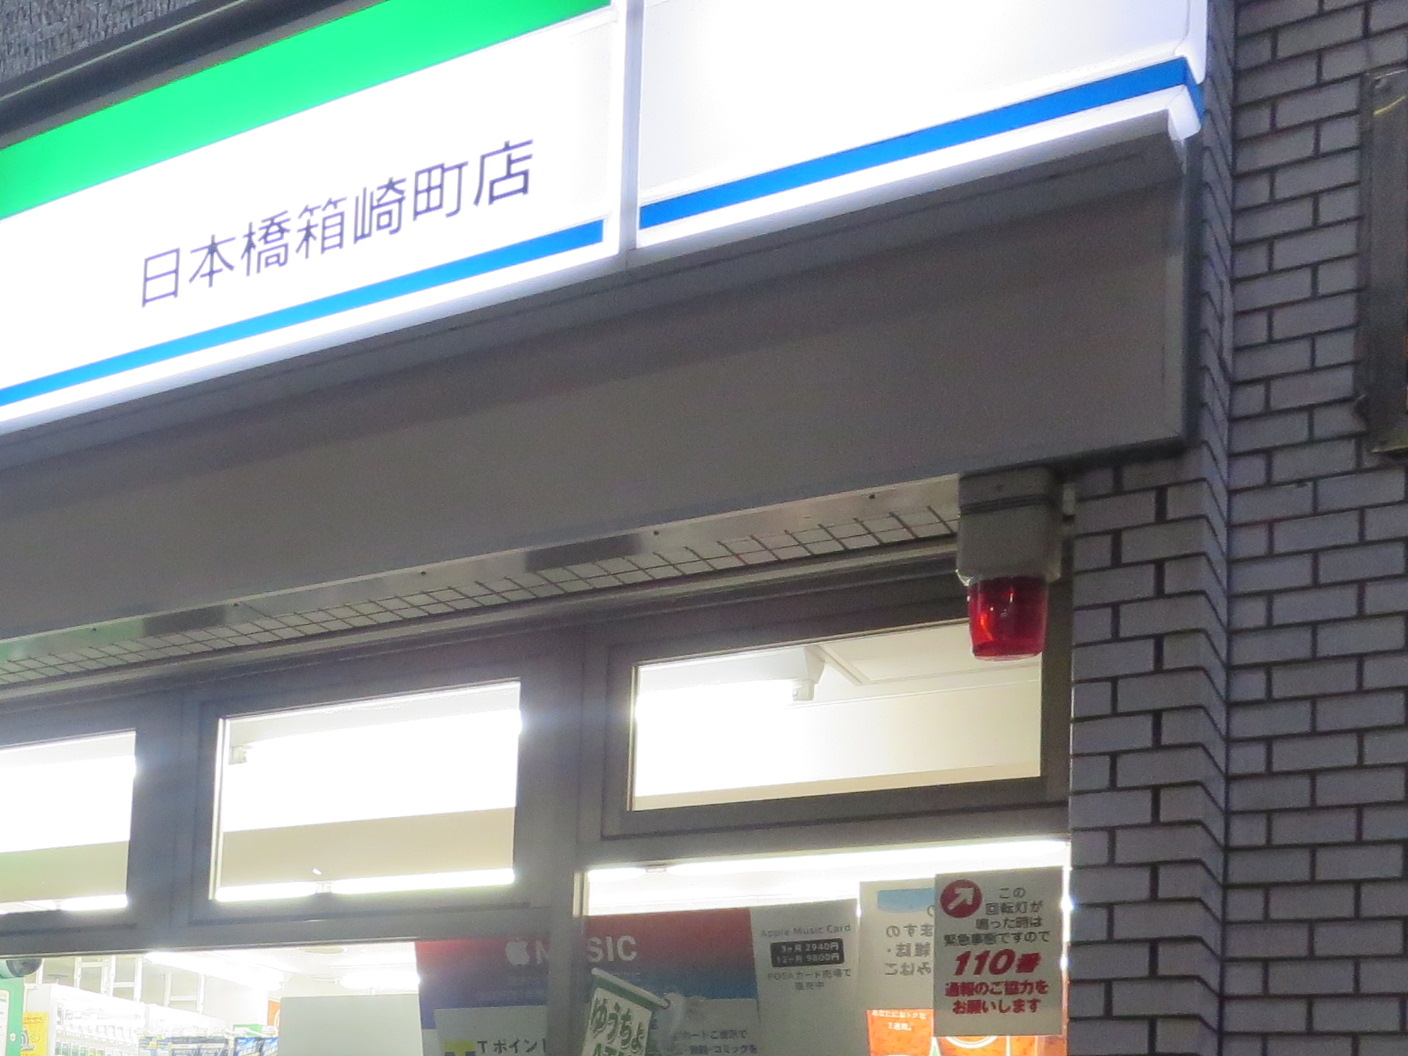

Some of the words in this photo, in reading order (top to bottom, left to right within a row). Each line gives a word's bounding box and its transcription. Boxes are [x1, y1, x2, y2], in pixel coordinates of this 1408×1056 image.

[142, 139, 534, 308] 日本橋箱崎町店
[999, 887, 1026, 899] この
[985, 902, 1044, 916] 回転灯が
[793, 926, 824, 936] Music
[826, 923, 851, 934] Card
[975, 916, 1043, 931] 鳴った時は
[943, 931, 1051, 947] 緊急事態ですので
[954, 949, 1042, 976] 110番
[945, 979, 1049, 998] 通報のご協力を
[952, 999, 1042, 1015] お願いします
[590, 998, 645, 1053] ゆうちょ
